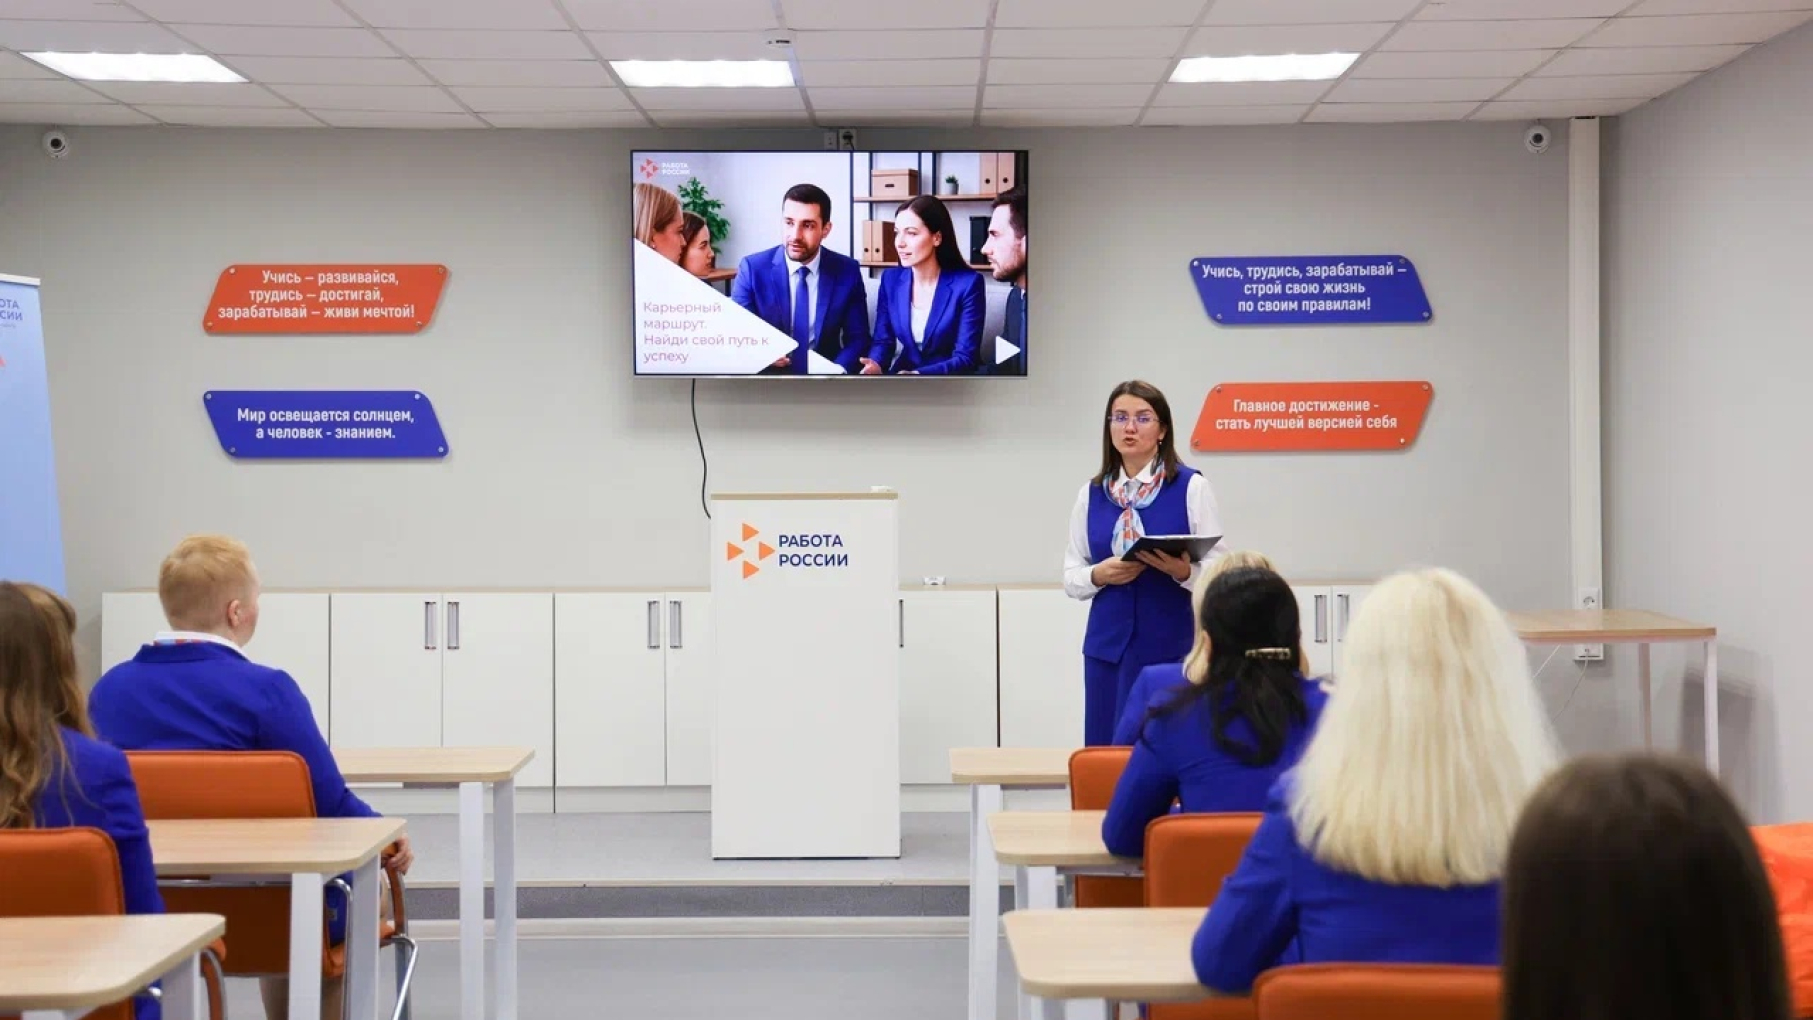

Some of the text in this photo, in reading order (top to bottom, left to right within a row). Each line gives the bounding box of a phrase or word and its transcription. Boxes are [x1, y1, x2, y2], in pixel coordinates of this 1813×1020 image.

[1202, 265, 1243, 279] Учись,
[1247, 264, 1303, 279] трудись,
[1306, 262, 1394, 277] зарабатывай
[262, 270, 301, 284] Учись
[318, 270, 399, 286] развивайся,
[1244, 281, 1365, 295] строй свою жизнь
[249, 290, 303, 303] трудись
[319, 288, 384, 303] достигай,
[643, 302, 722, 314] Карьерный
[1238, 297, 1371, 313] по своим правилам!
[218, 305, 307, 320] зарабатывай
[324, 307, 359, 318] живи
[363, 305, 415, 318] мечтой!
[643, 319, 707, 331] маршрут.
[644, 334, 688, 346] Найди
[692, 334, 725, 345] свой
[728, 337, 758, 347] путь
[643, 352, 689, 363] успеху
[1233, 399, 1286, 412] Главное
[1289, 400, 1370, 413] достижение
[238, 408, 414, 423] Мир освещается солнцем,
[1216, 415, 1397, 432] стать лучшей версией себя
[256, 429, 264, 439] а
[268, 428, 323, 439] человек
[335, 428, 396, 439] знанием.
[778, 534, 843, 548] РАБОТА
[778, 553, 848, 567] РОССИИ
